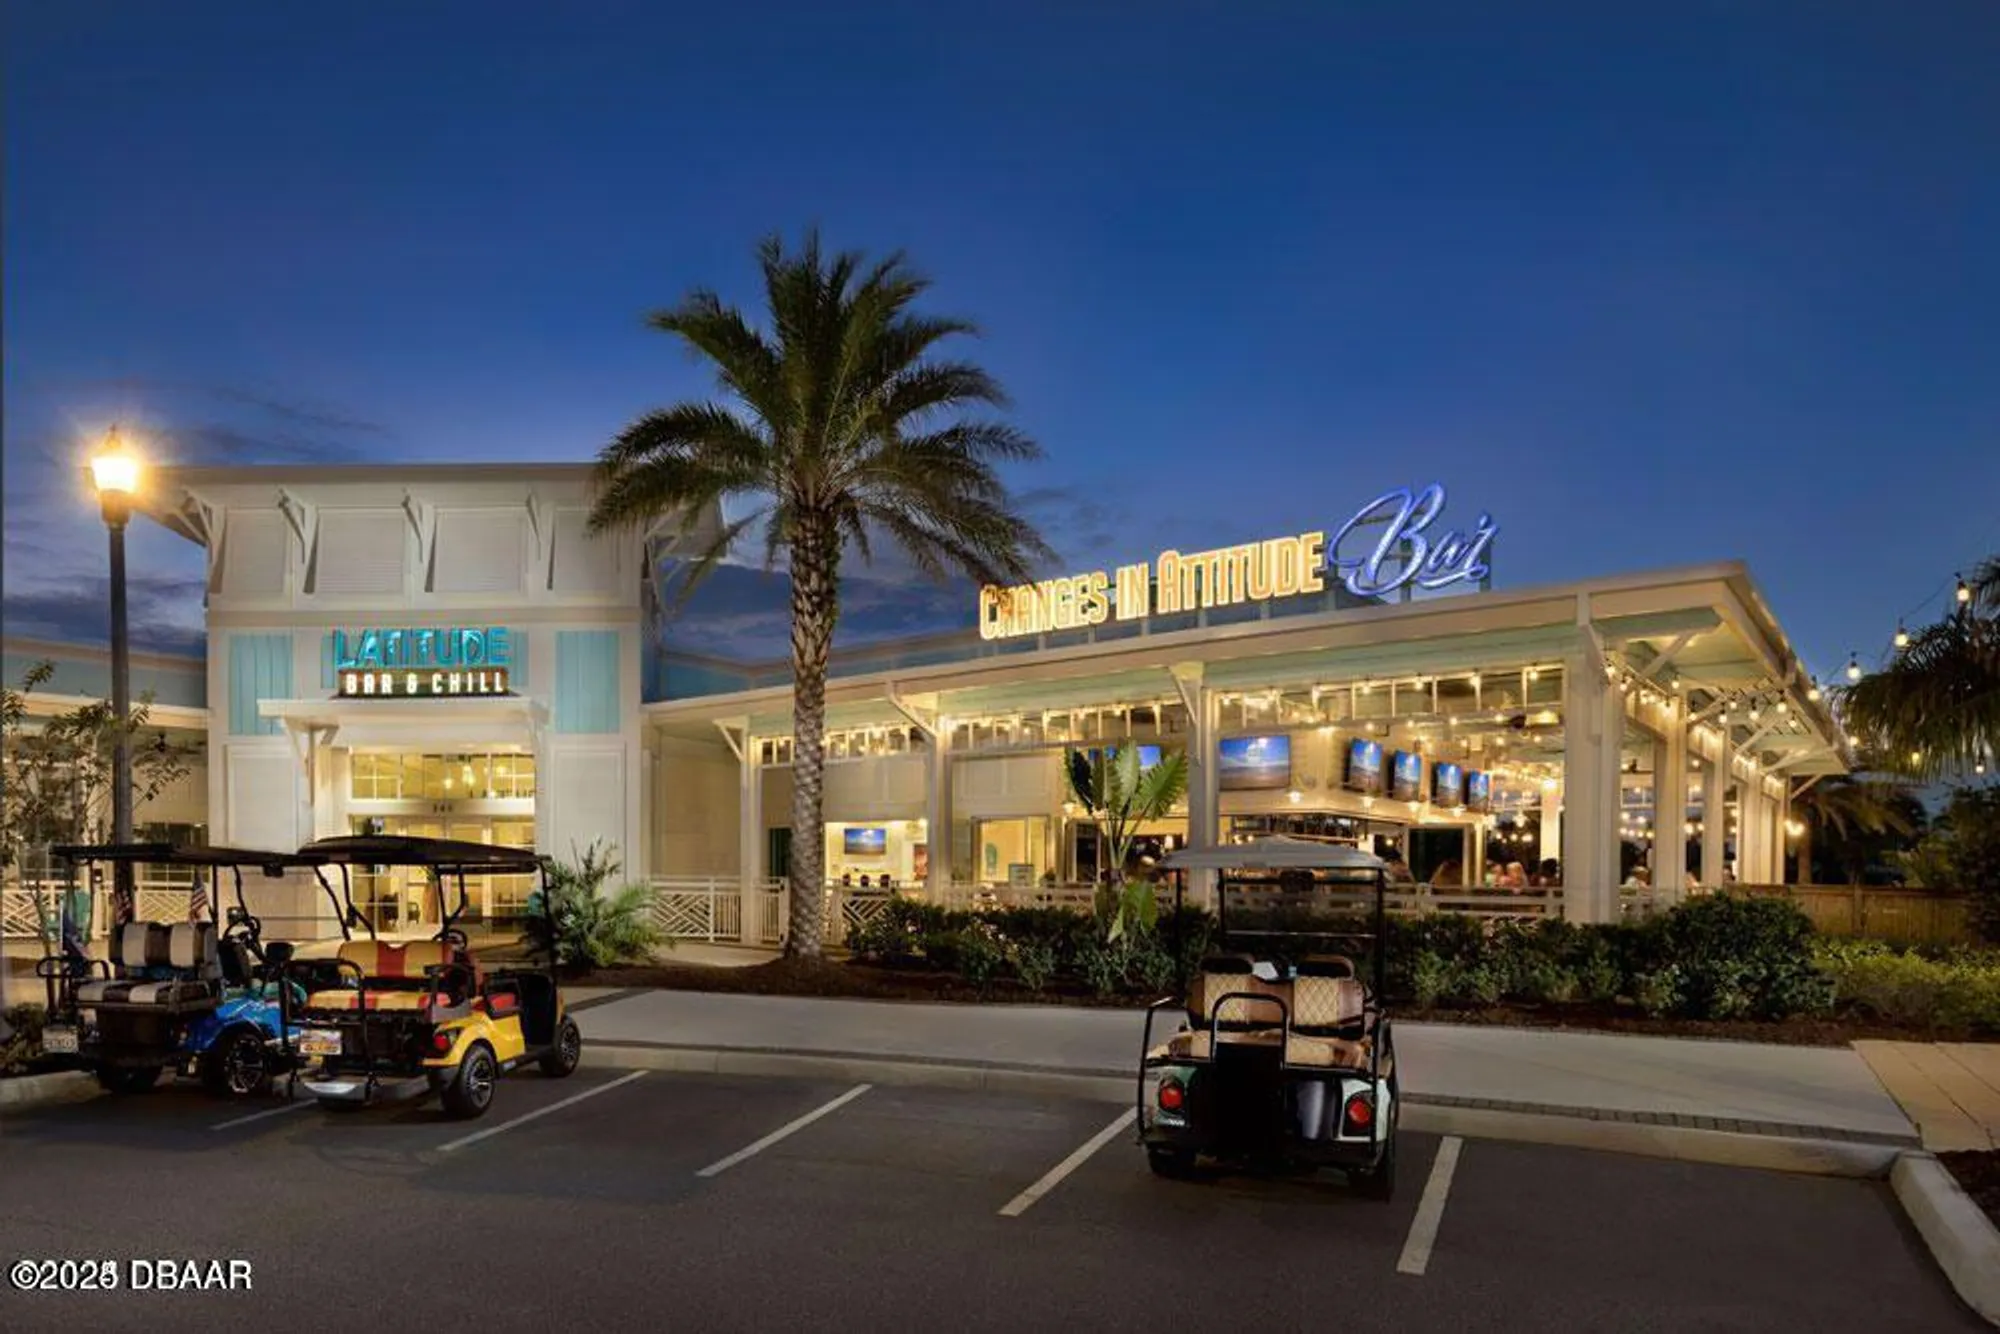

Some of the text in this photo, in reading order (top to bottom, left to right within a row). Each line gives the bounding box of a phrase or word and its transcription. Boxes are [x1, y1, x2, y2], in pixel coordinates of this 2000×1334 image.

[1116, 563, 1149, 621] IN
[1157, 531, 1324, 615] ATTITUDE
[333, 627, 511, 668] LATITUDE
[345, 671, 504, 695] BAR & CHILL
